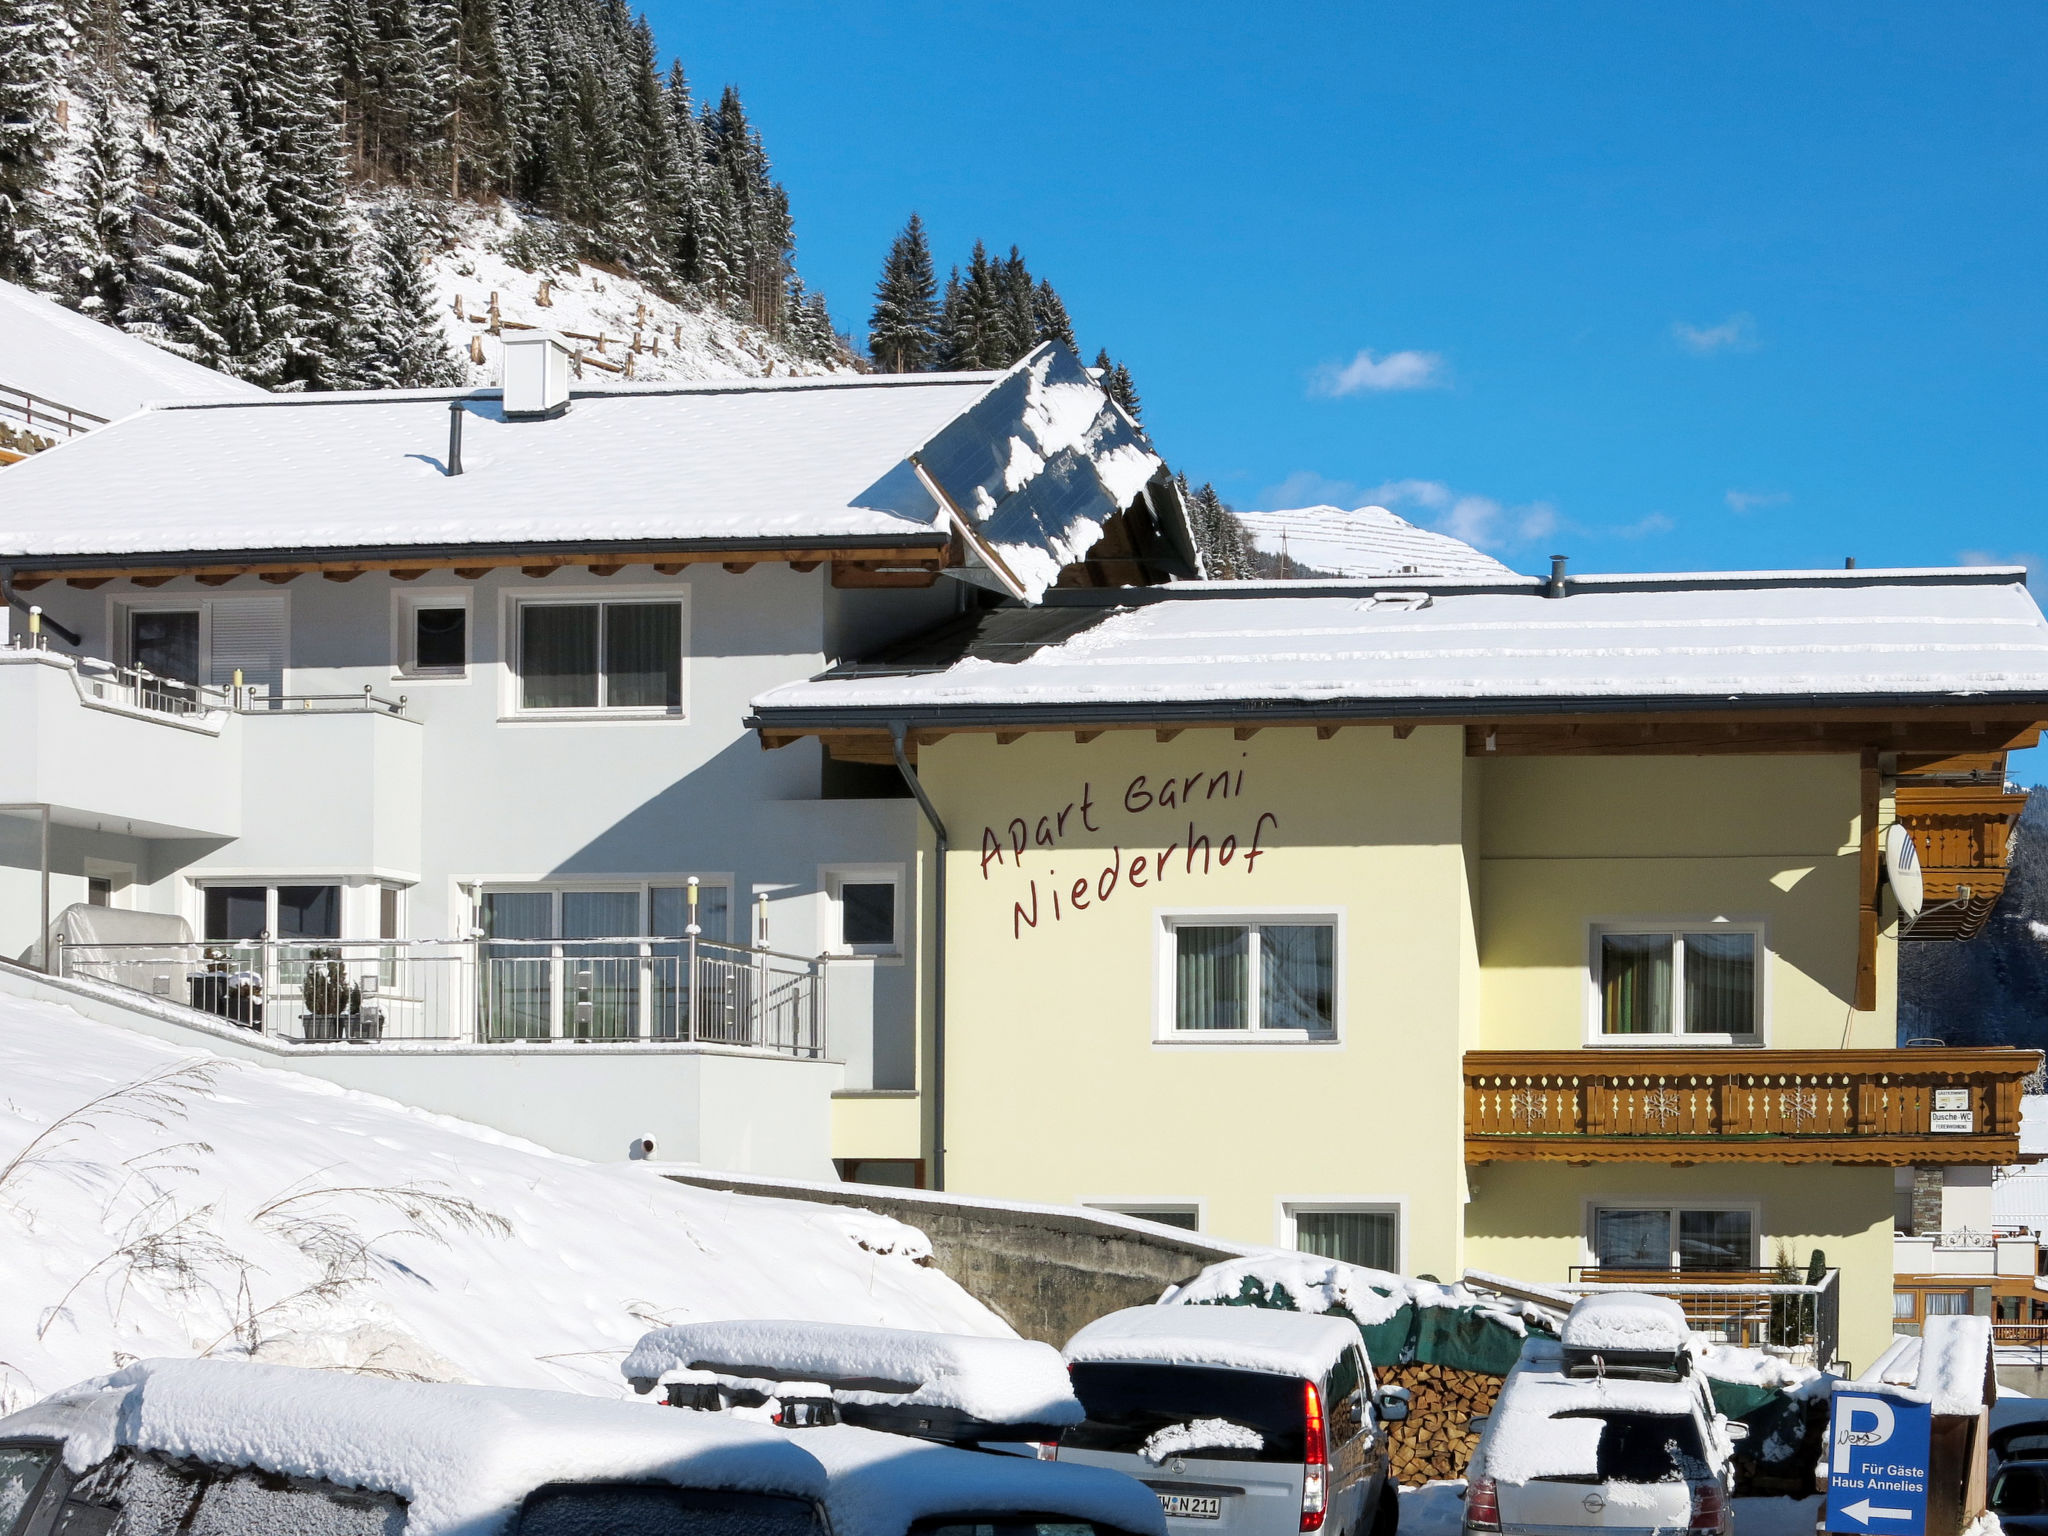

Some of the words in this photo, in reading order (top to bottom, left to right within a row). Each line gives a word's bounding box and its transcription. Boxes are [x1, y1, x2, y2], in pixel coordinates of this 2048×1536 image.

[1125, 752, 1247, 813] Garni
[1014, 812, 1277, 939] Niederhof
[1833, 1396, 1895, 1474] P
[1832, 1476, 1864, 1489] Haus
[1867, 1478, 1923, 1492] Annelies
[1861, 1463, 1884, 1475] Für
[1887, 1464, 1924, 1478] Gäste
